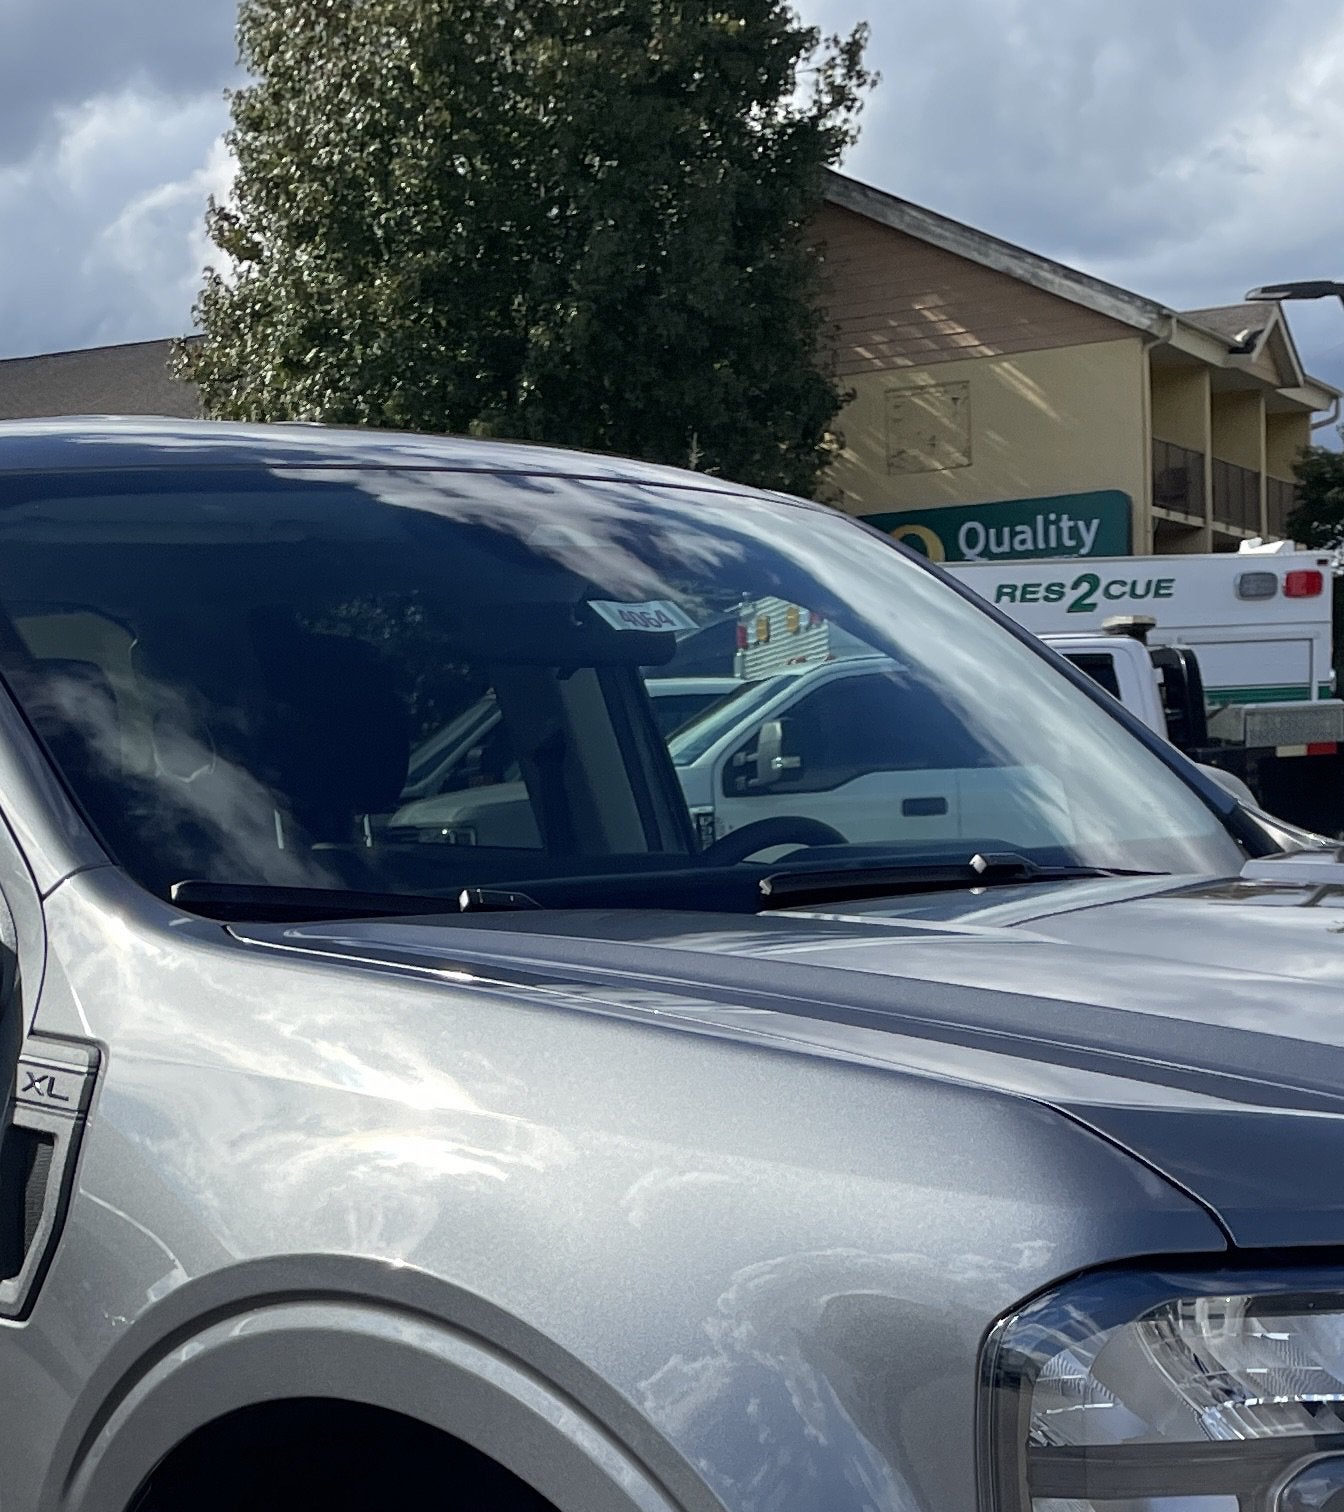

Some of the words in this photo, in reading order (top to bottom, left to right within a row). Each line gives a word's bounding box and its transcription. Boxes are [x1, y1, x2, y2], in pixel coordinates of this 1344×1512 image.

[958, 512, 1100, 562] Quality
[994, 572, 1176, 613] RES2CUE
[21, 1071, 70, 1102] XL
